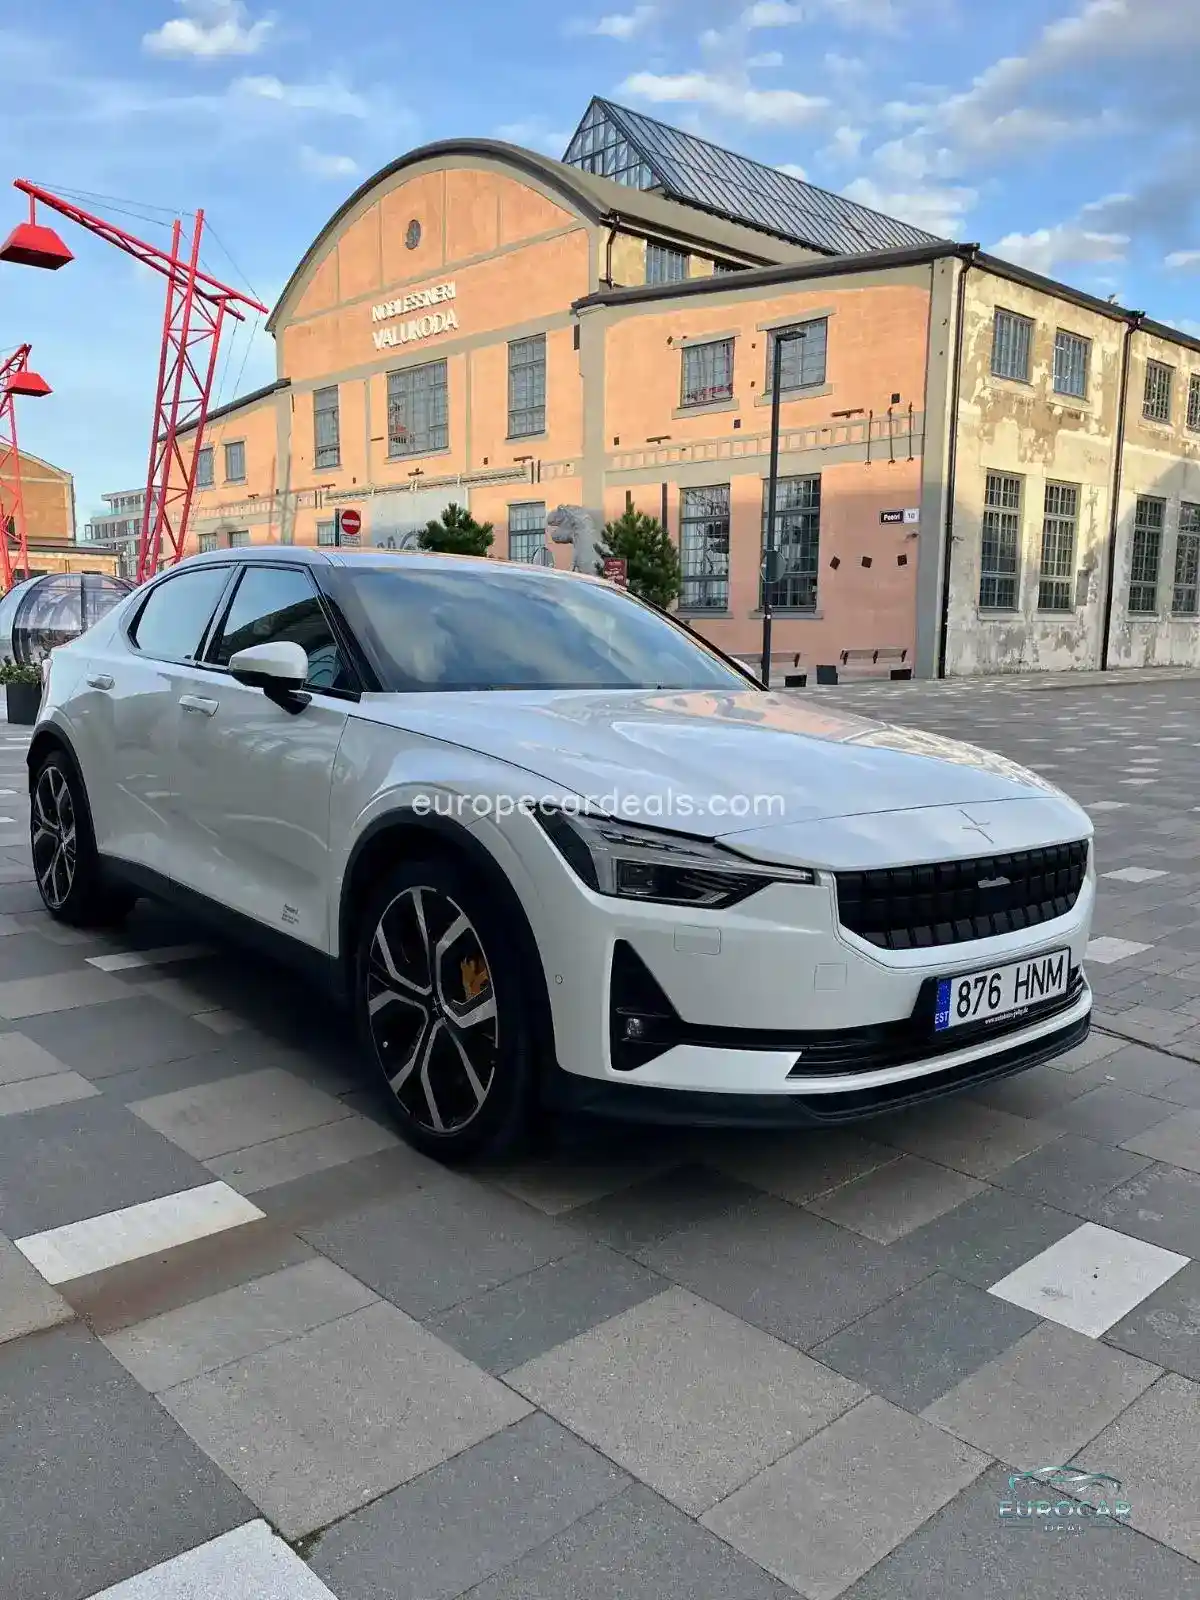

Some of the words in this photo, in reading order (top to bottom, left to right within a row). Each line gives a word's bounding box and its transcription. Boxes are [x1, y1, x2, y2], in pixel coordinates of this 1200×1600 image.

[372, 308, 459, 350] VALUKODA
[934, 1010, 949, 1024] EST
[957, 972, 1002, 1018] 876
[1013, 954, 1064, 1003] HNM
